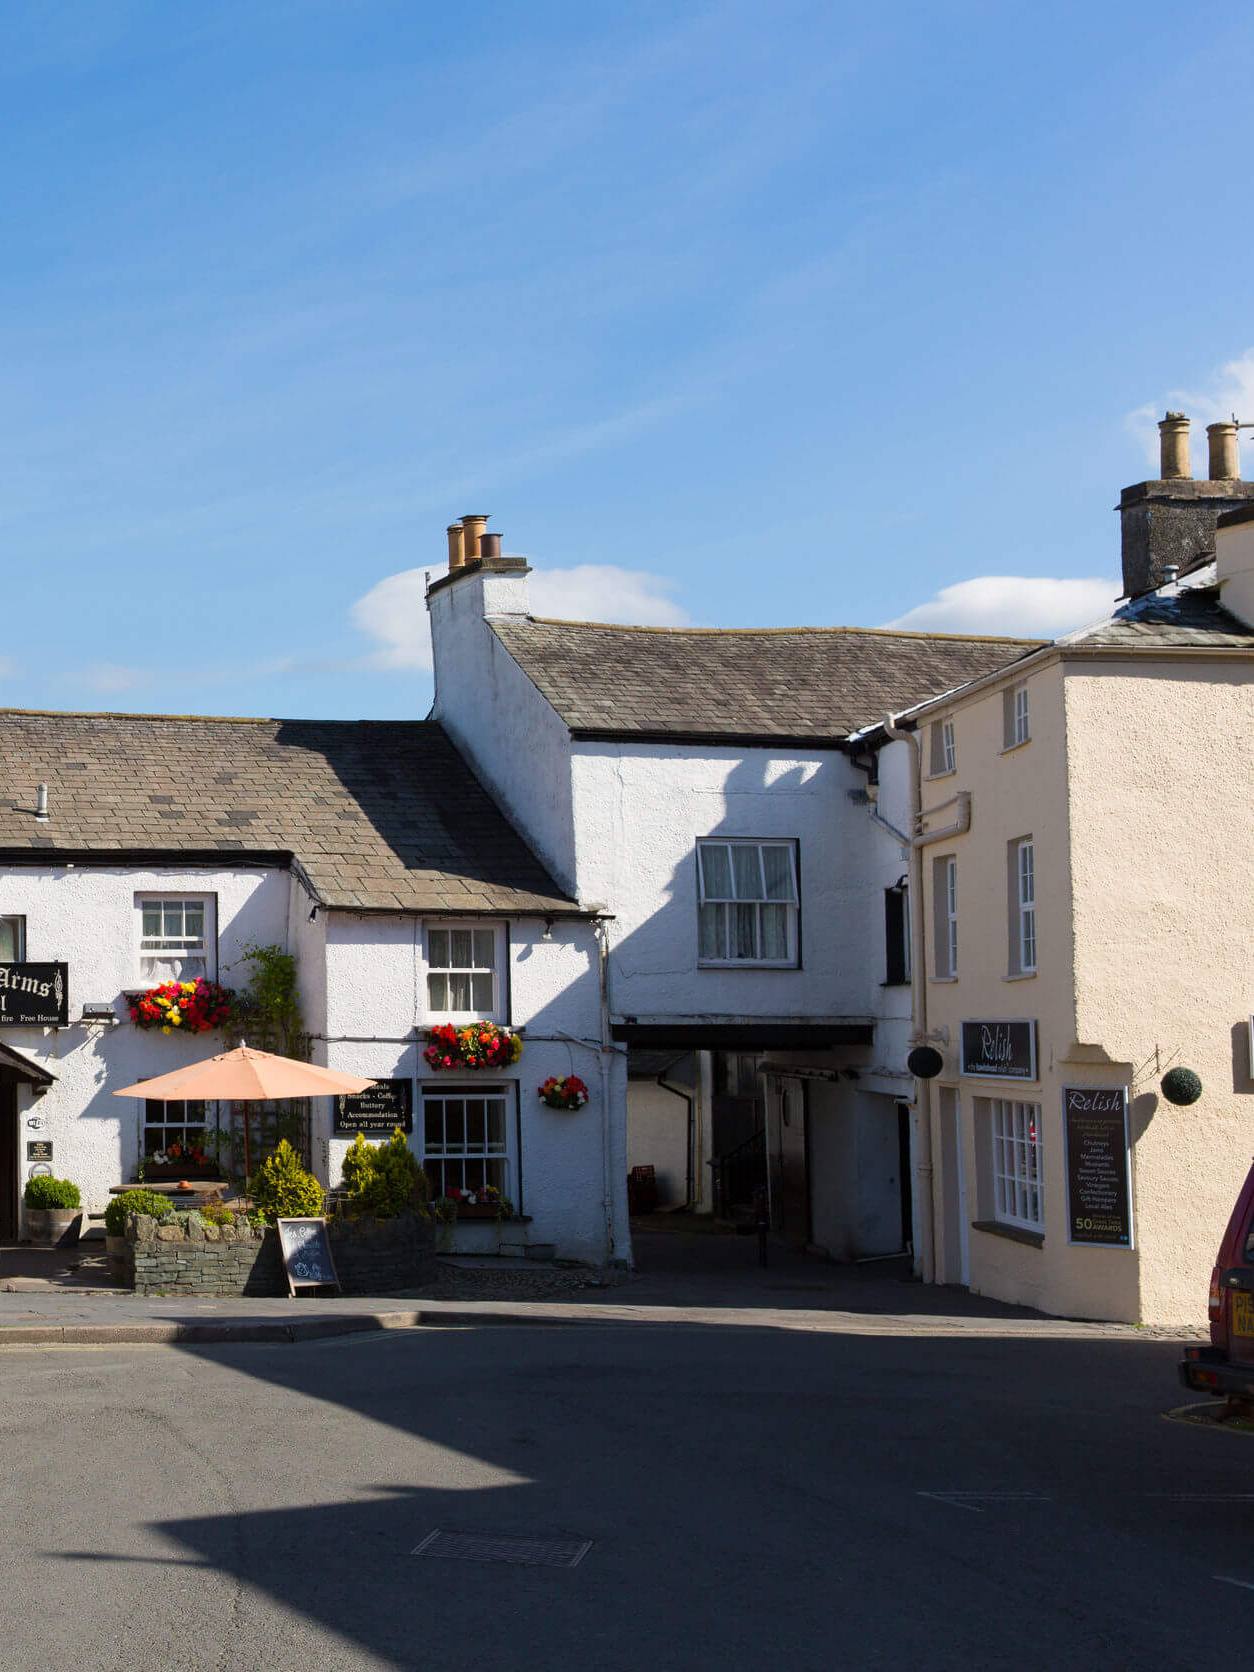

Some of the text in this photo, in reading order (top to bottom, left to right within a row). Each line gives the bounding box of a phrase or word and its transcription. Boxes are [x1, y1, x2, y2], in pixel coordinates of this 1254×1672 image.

[1, 1014, 14, 1023] fire
[20, 1014, 36, 1023] Free
[37, 1014, 59, 1023] House
[981, 1024, 1012, 1062] Relish
[1069, 1091, 1122, 1111] Relish
[339, 1120, 358, 1129] Open
[369, 1121, 384, 1129] year
[1075, 1217, 1092, 1230] 50
[1092, 1224, 1122, 1233] AWARDS
